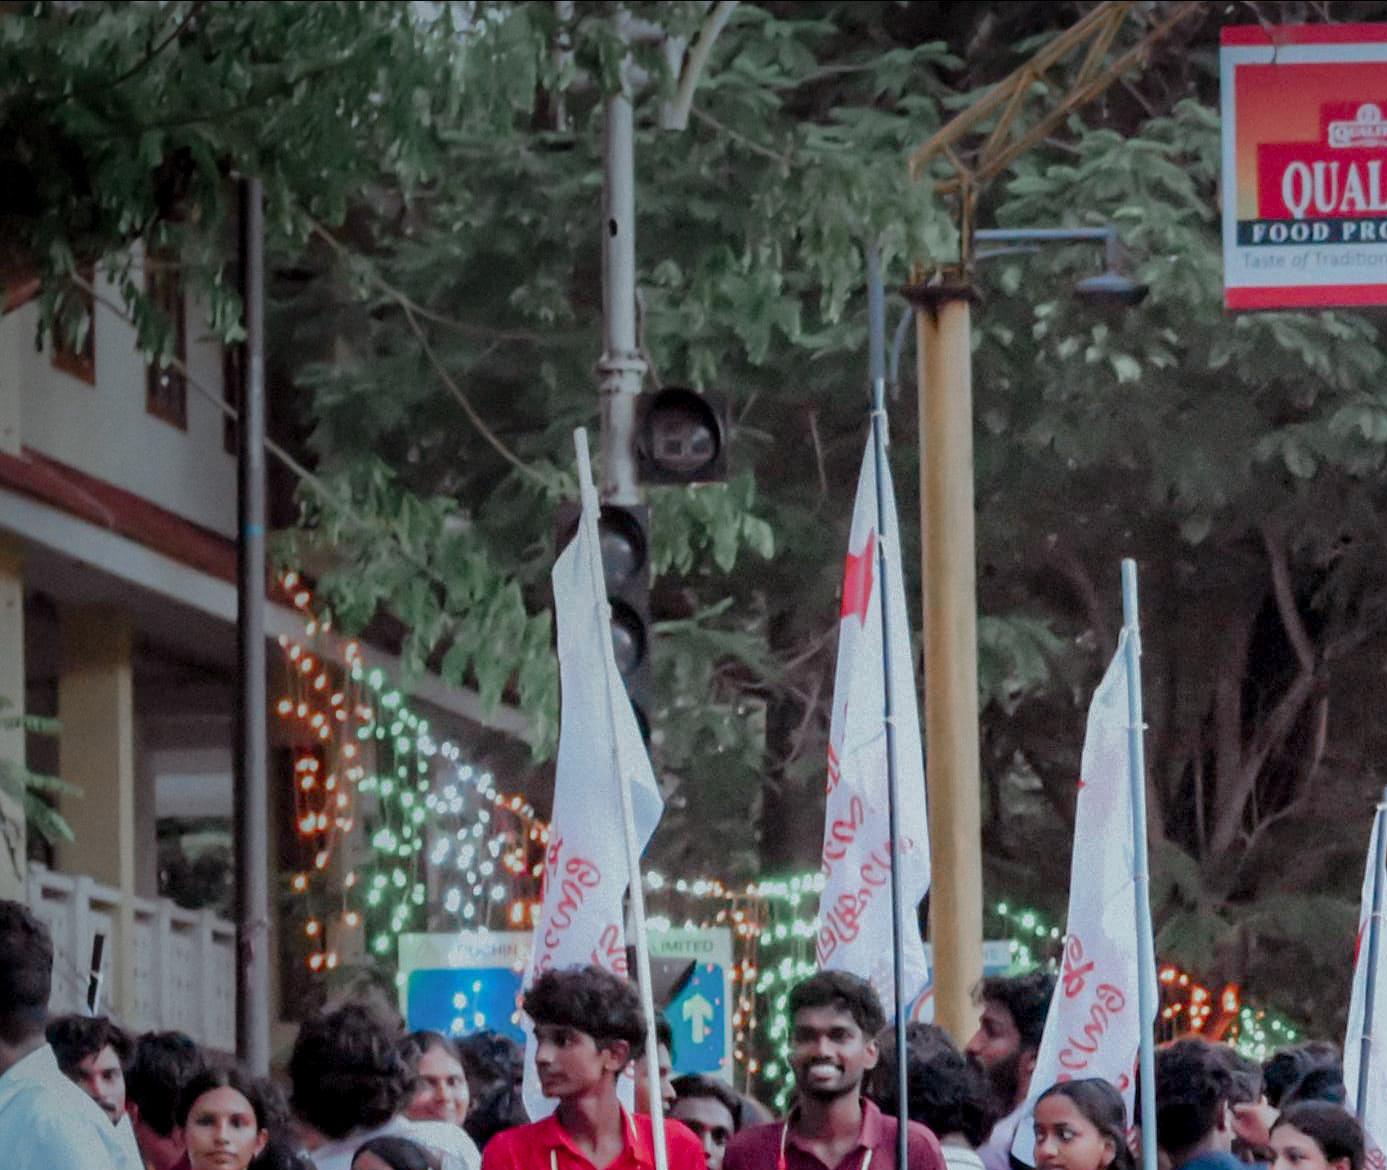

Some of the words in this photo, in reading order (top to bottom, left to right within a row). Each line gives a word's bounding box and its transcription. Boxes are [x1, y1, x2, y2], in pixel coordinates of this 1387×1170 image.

[1251, 221, 1330, 243] FOOD
[1243, 251, 1286, 269] Taste
[1291, 251, 1310, 270] of
